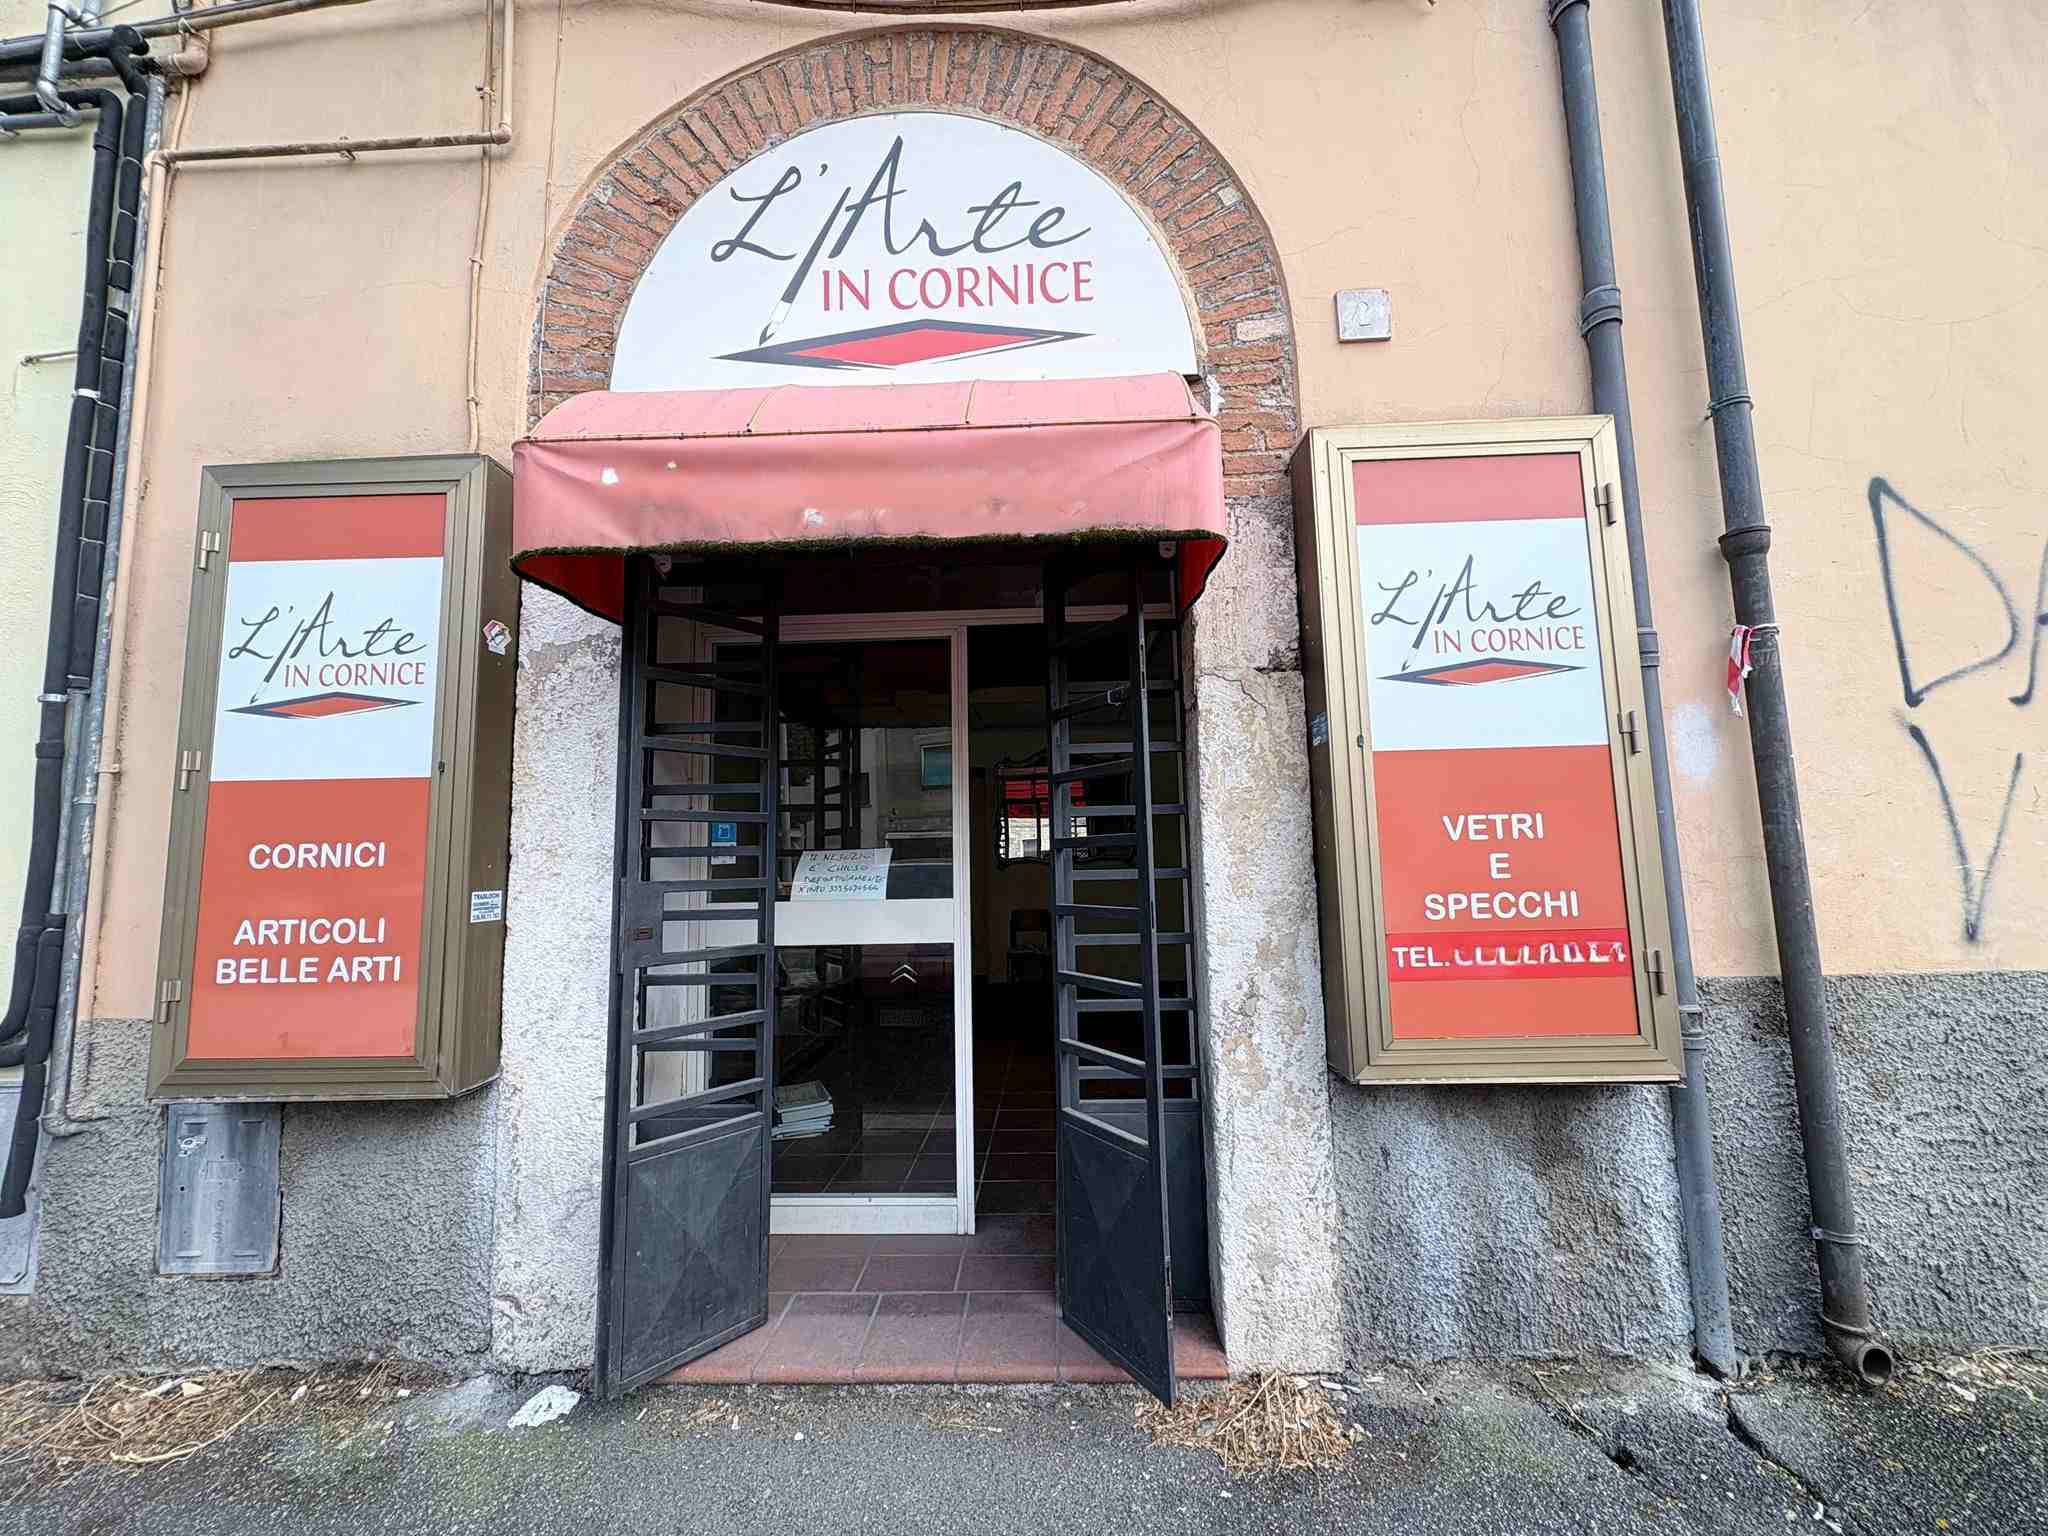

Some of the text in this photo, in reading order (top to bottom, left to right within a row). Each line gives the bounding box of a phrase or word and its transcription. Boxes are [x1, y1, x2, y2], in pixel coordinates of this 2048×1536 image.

[710, 135, 1093, 263] L'Arte
[822, 260, 1094, 312] IN CORNICE
[1371, 554, 1582, 626] L'Arte
[228, 591, 427, 660] L'Arte
[1434, 625, 1585, 654] IN CORNICE
[284, 661, 426, 688] IN CORNICE
[1441, 812, 1544, 841] VETRI
[248, 842, 386, 869] CORNICI
[1489, 852, 1512, 880] E
[1424, 890, 1579, 920] SPECCHI
[233, 917, 385, 945] ARTICOLI
[216, 955, 401, 984] BELLE ARTI
[1391, 946, 1451, 969] TEL.
